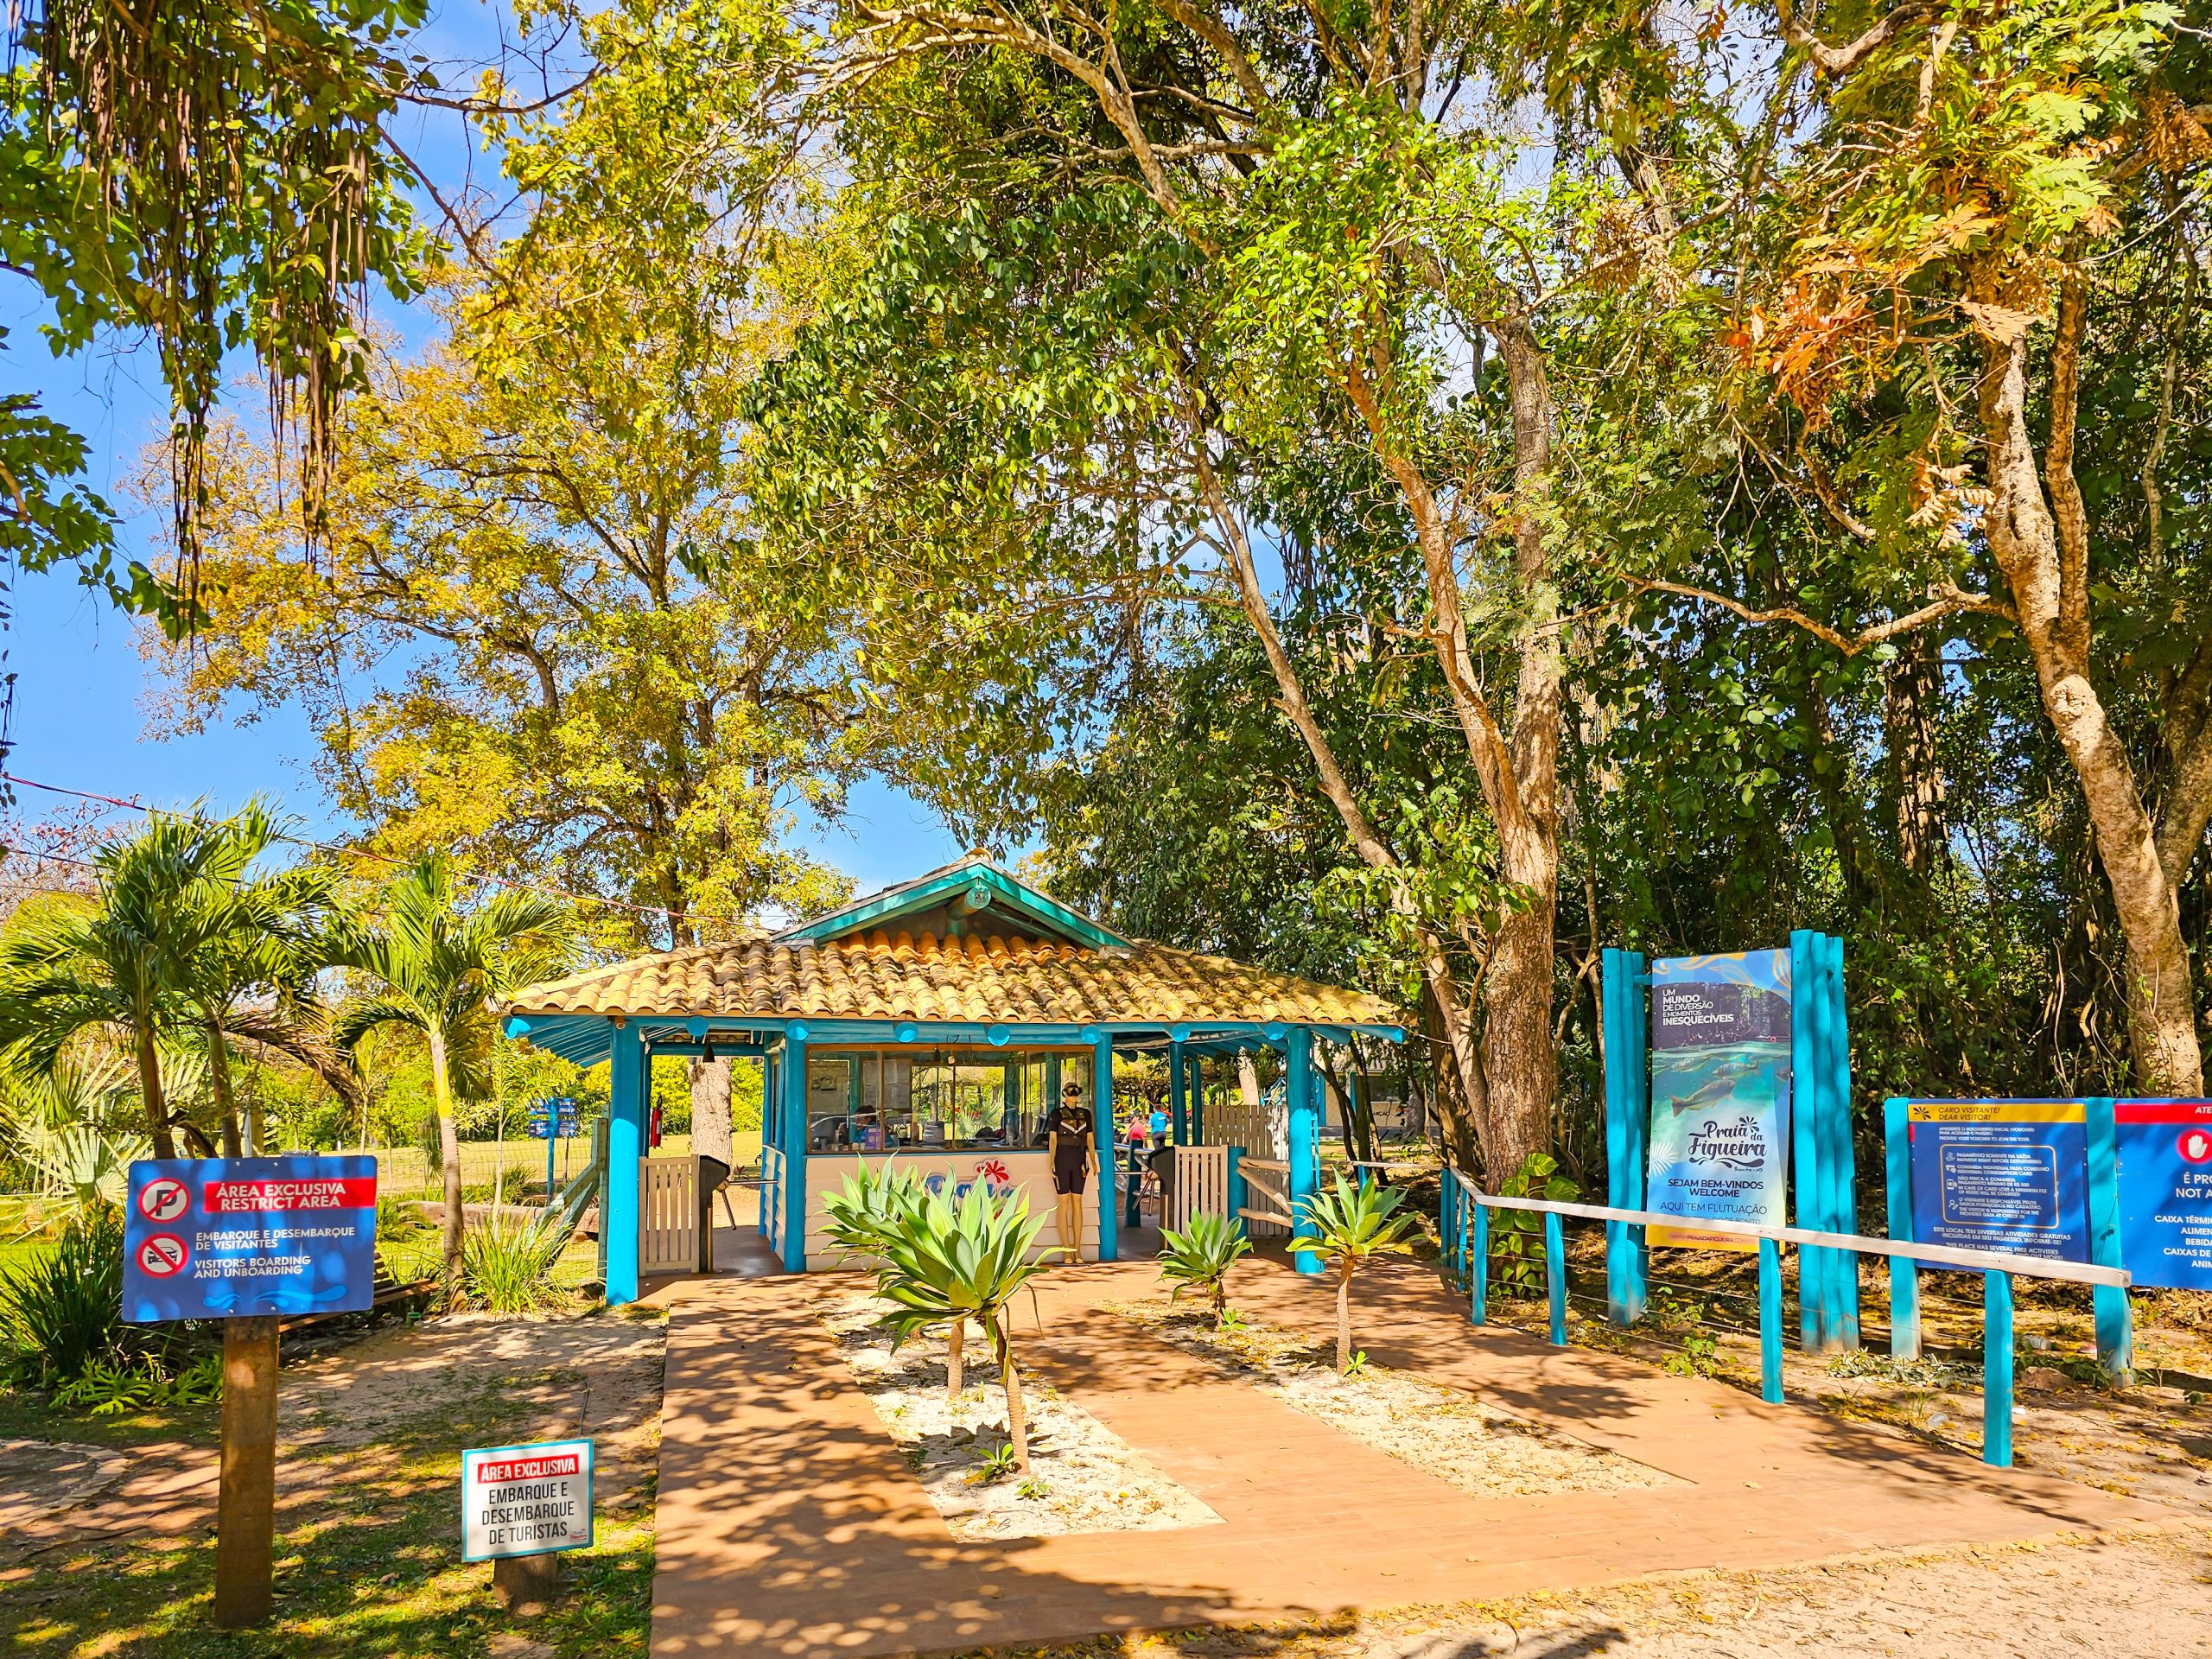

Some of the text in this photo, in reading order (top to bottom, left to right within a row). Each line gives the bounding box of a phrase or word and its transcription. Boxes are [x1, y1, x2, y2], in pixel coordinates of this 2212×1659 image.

[1662, 995, 1700, 1004] MUNDO
[1675, 1001, 1713, 1011] DIVERSÃO
[1662, 1013, 1734, 1026] INESQUECÍVEIS
[1704, 1121, 1763, 1141] Praia da
[1688, 1133, 1767, 1160] Figueira
[1668, 1179, 1764, 1189] SEJAM BEM-VINDOS
[2183, 1172, 2190, 1184] É
[216, 1183, 346, 1198] ÁREA EXCLUSIVA
[1689, 1188, 1740, 1198] WELCOME
[2176, 1188, 2201, 1198] NOT
[221, 1195, 340, 1211] RESTRICT AREA
[1660, 1202, 1767, 1216] AQUI TEM FLUTUAÇÃO
[2154, 1215, 2183, 1224] CAIXA
[196, 1227, 355, 1242] EMBARQUE E DESEMBARQUE
[195, 1239, 278, 1250] DE VISITANTES
[2164, 1248, 2197, 1256] CAIXAS
[194, 1255, 311, 1269] VISITORS BOARDING
[194, 1265, 302, 1279] AND UNBOARDING
[480, 1458, 575, 1482] ÁREA EXCLUSIVA
[489, 1482, 568, 1504] EMBARQUE E
[482, 1501, 575, 1525] DESEMBARQUE
[489, 1529, 505, 1544] DE
[509, 1522, 568, 1542] TURISTAS
